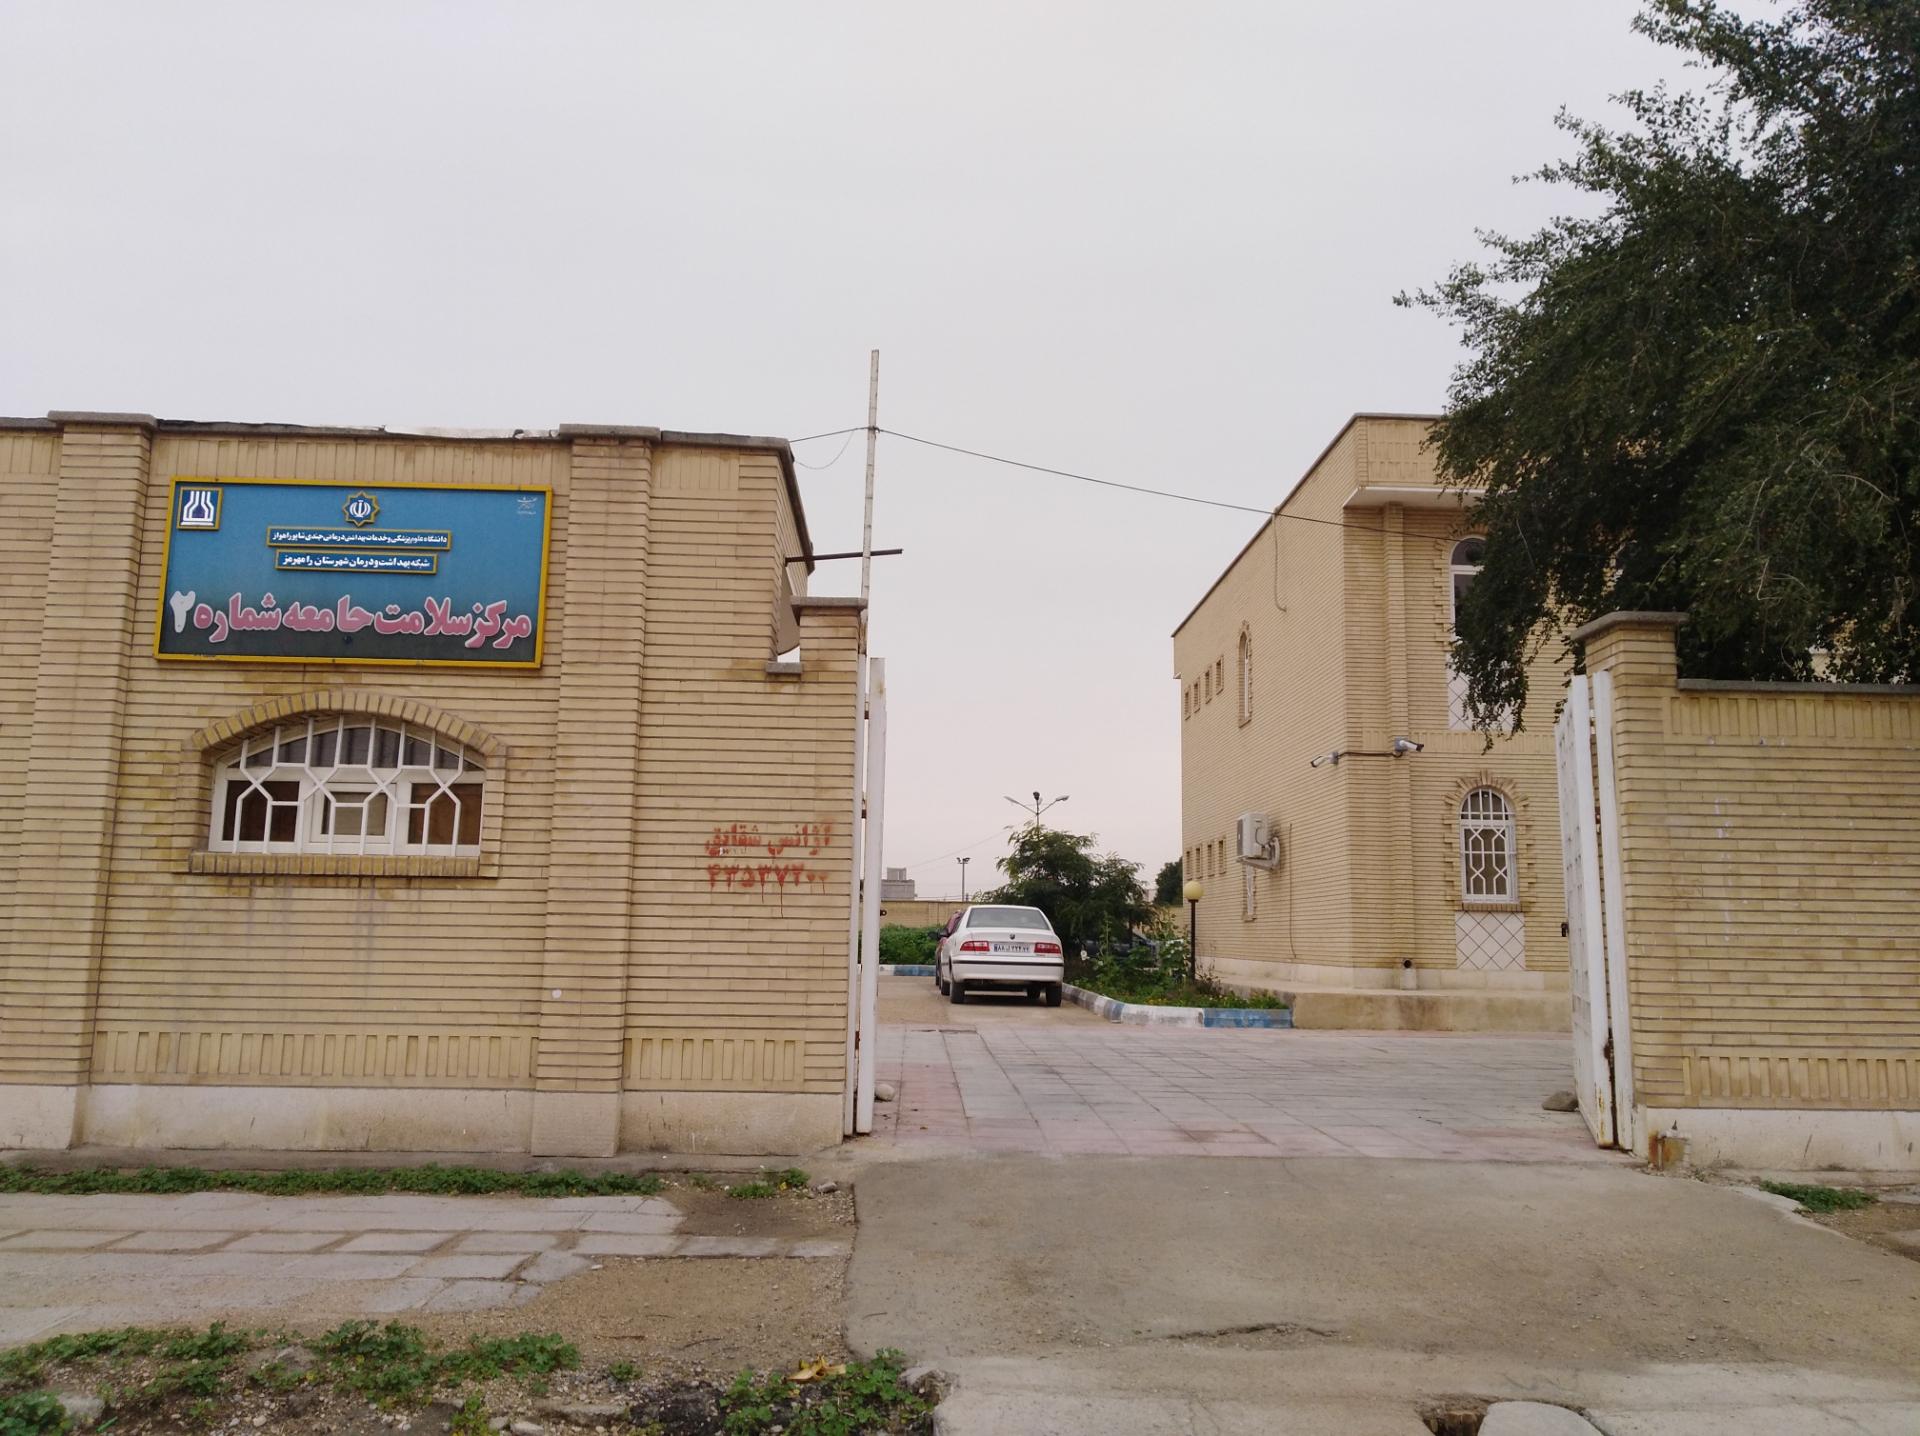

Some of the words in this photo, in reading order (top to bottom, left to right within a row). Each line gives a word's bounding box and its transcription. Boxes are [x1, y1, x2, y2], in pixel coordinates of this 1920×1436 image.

[272, 531, 290, 541] اهواز
[323, 532, 346, 542] درمانی
[365, 533, 387, 542] خدمات
[390, 534, 411, 544] پزشکی
[423, 535, 447, 543] دانشگاه
[314, 555, 348, 567] شهرستان
[349, 556, 373, 567] درمان
[378, 556, 411, 569] بهداشت
[410, 558, 430, 568] شبکه
[170, 591, 195, 633] ۲
[193, 592, 282, 643] شماره
[374, 596, 472, 636] سلامت
[465, 599, 532, 649] مرکز
